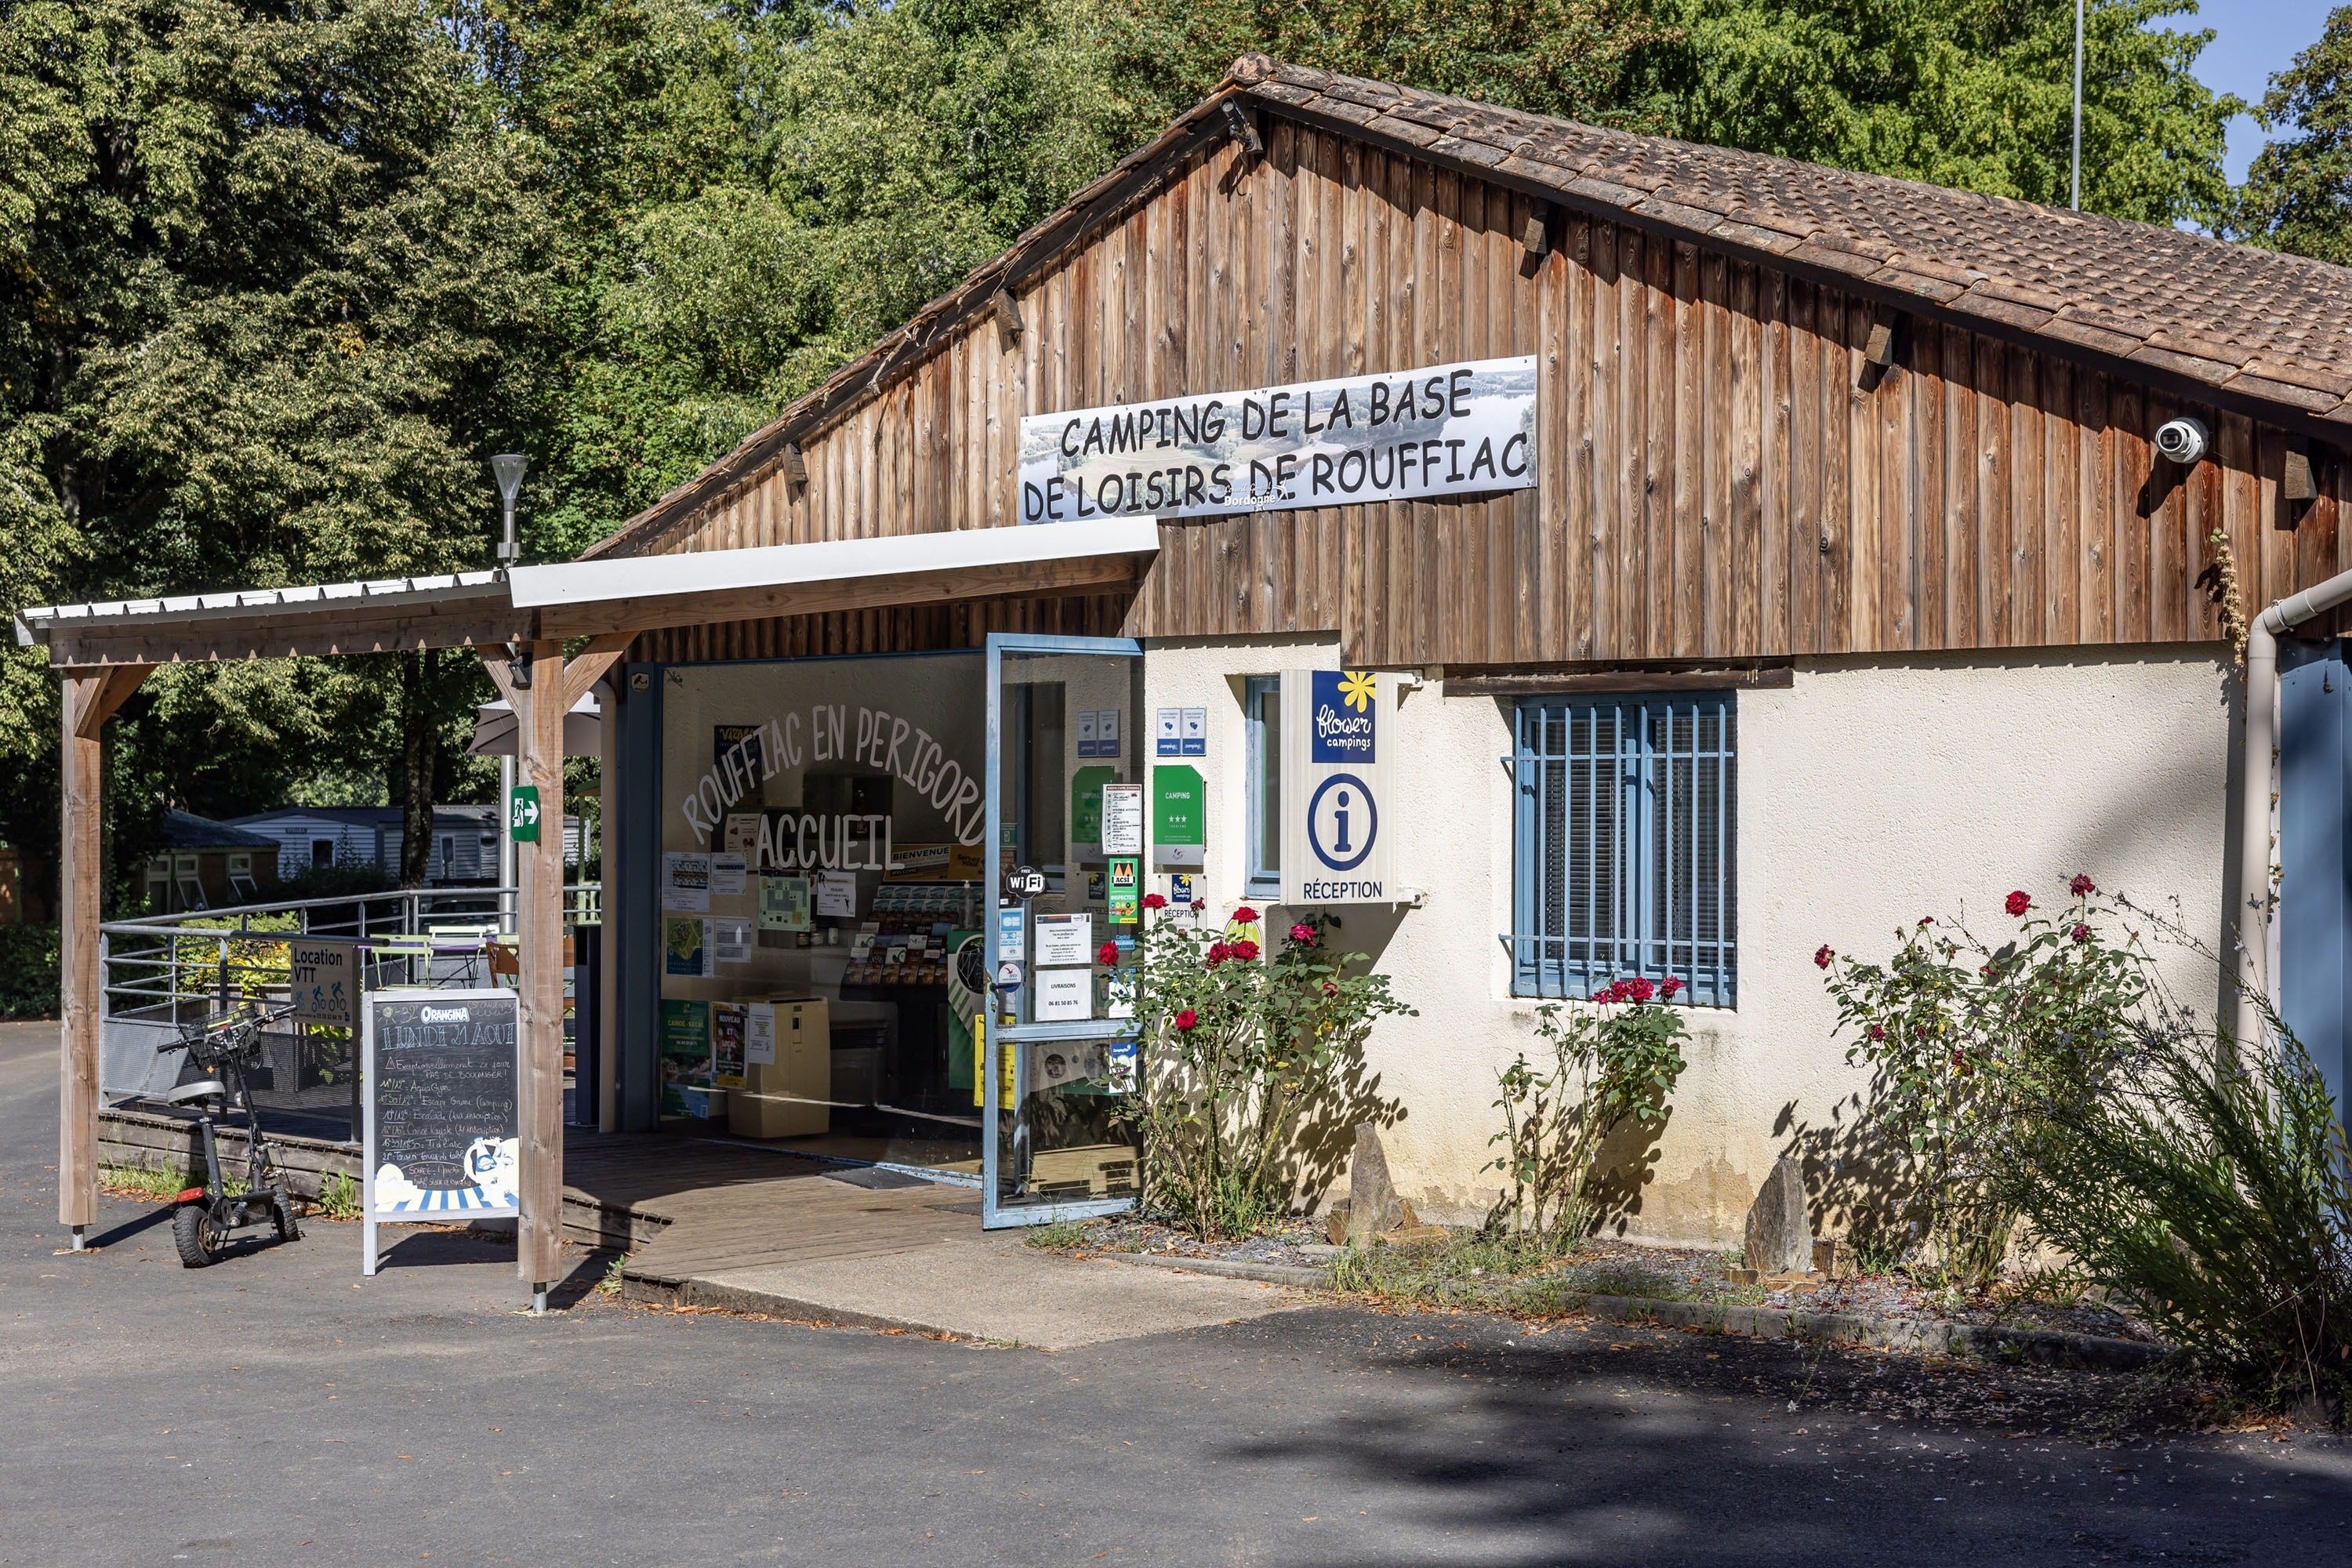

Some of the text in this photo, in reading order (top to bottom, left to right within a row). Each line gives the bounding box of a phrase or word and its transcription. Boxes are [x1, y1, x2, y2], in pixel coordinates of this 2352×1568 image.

[1061, 369, 1473, 458] CAMPING DE LA BASE
[1024, 432, 1527, 521] DE LOISIRS DE ROUFFIAC
[1225, 495, 1276, 507] Dordogne
[1316, 704, 1371, 739] flower
[1327, 735, 1371, 751] campings
[681, 712, 803, 845] ROUFFIAC
[812, 704, 846, 761] EN
[756, 814, 905, 870] ACCUEIL
[893, 846, 949, 860] BIENVENUE
[1304, 878, 1382, 899] RÉCEPTION
[294, 947, 343, 966] Location
[294, 966, 316, 983] VTT
[422, 1006, 470, 1024] ORANGINA
[719, 1014, 741, 1024] NOUVEAU
[382, 1025, 447, 1050] LUNDI
[452, 1025, 468, 1045] 21
[721, 1040, 737, 1048] LOCAL
[425, 1069, 440, 1080] PAS
[445, 1070, 456, 1080] DE
